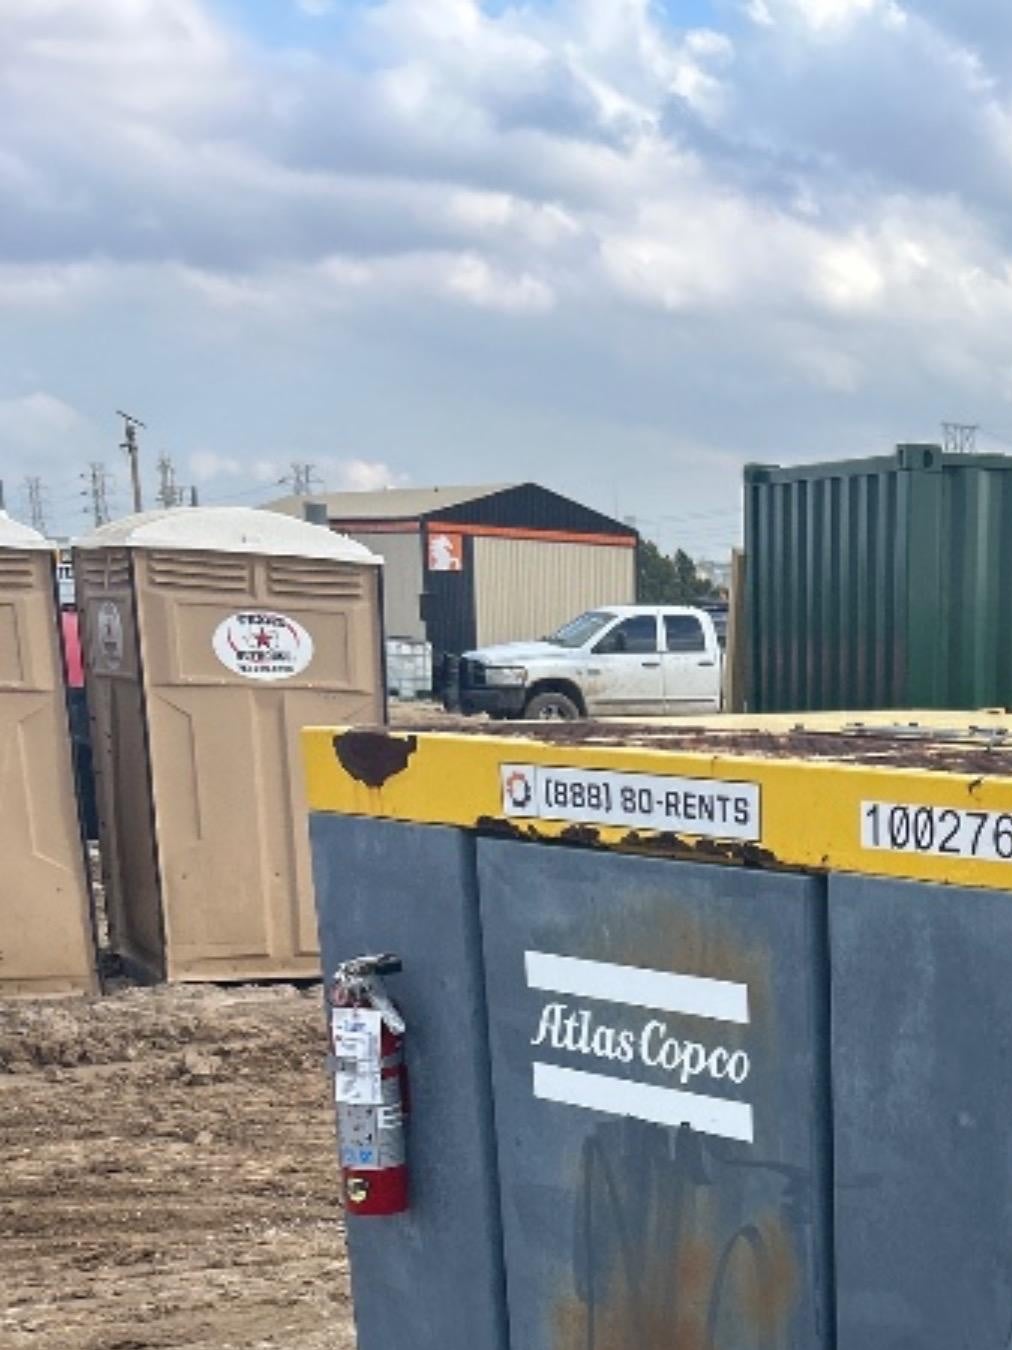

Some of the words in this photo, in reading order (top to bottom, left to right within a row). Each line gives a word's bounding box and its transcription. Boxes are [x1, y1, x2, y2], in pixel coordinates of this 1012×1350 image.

[544, 777, 612, 813] (888)
[619, 785, 749, 827] 80-RENTS
[530, 1002, 635, 1063] Atlas
[640, 1019, 751, 1085] Copco
